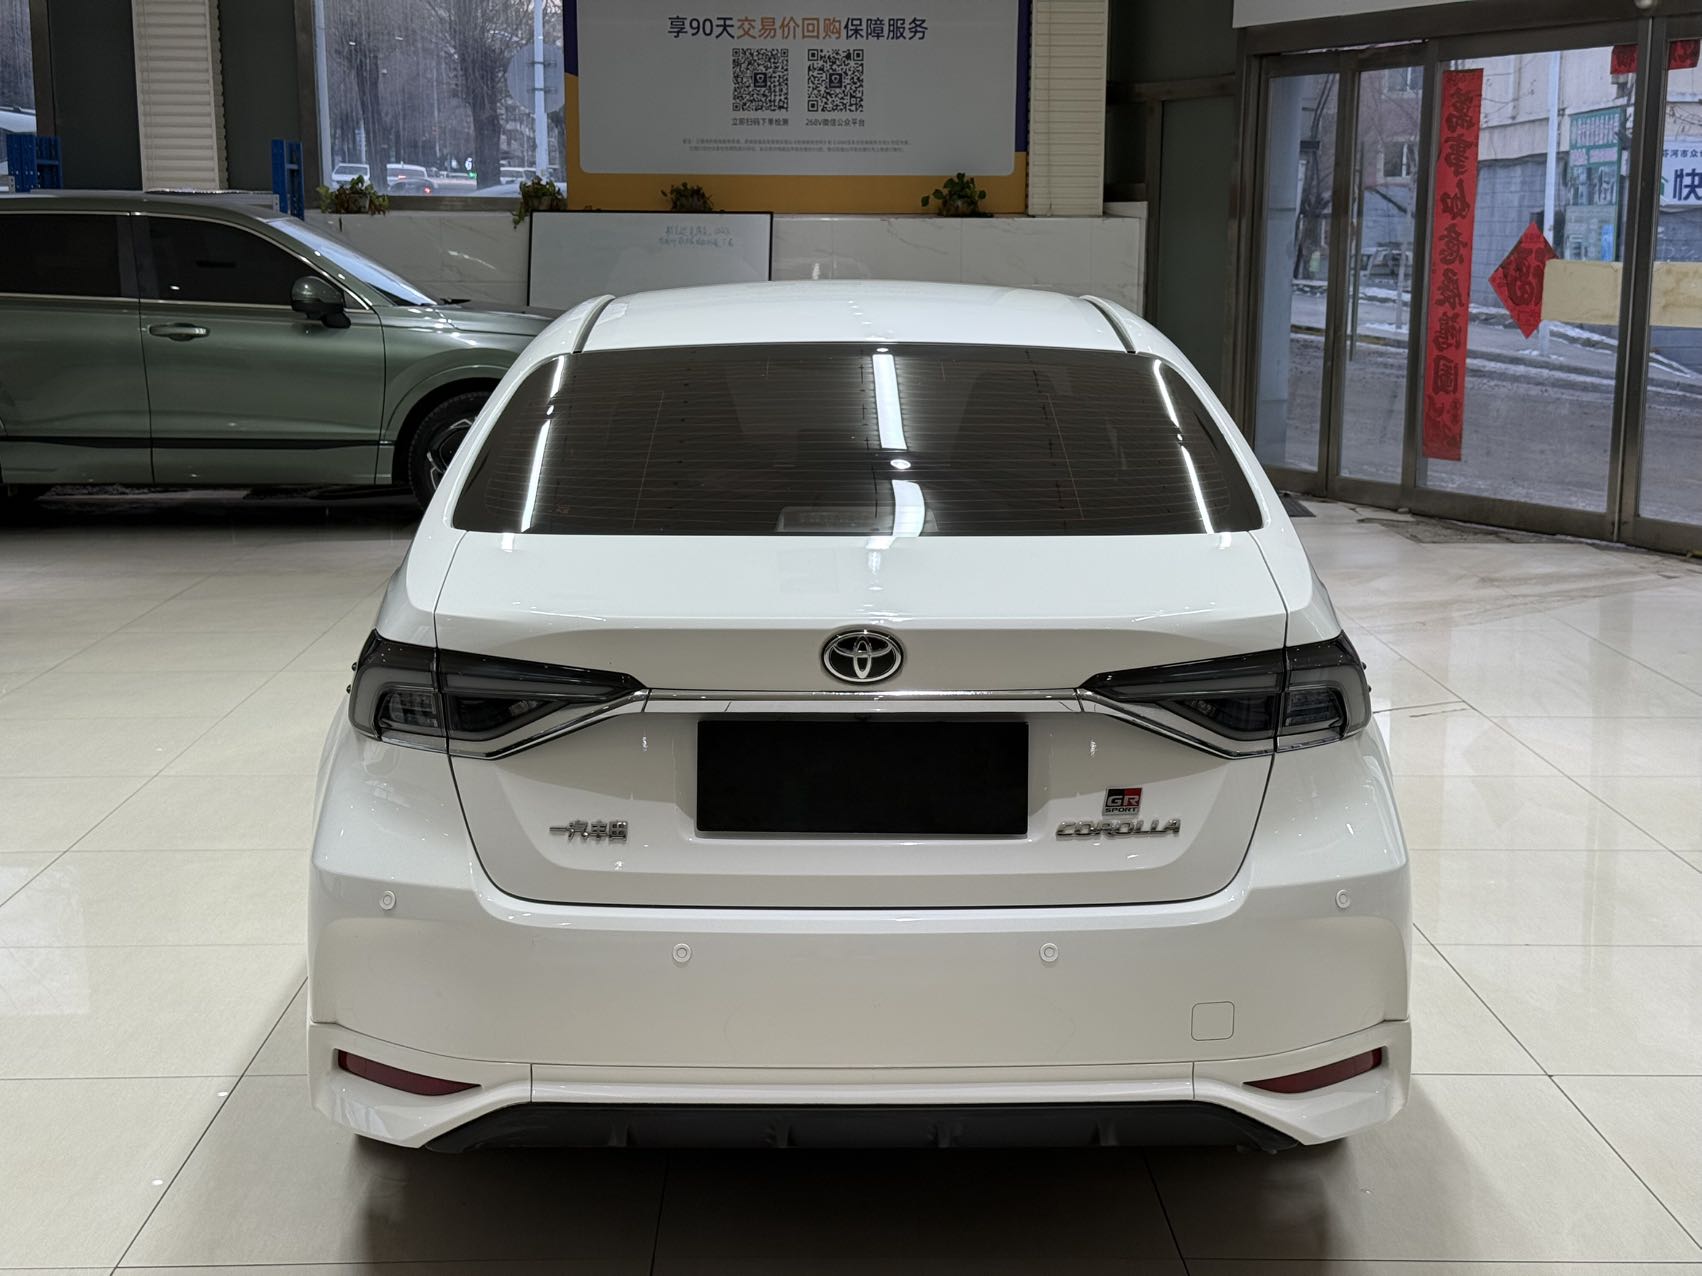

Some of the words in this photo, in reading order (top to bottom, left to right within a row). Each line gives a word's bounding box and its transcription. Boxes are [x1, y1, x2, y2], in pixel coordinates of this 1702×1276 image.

[668, 15, 928, 40] 享90天交易价回购保障服务
[1672, 168, 1702, 201] 快
[1106, 795, 1140, 807] GR
[549, 820, 628, 841] 一汽丰田
[1056, 819, 1181, 837] COROLLA
